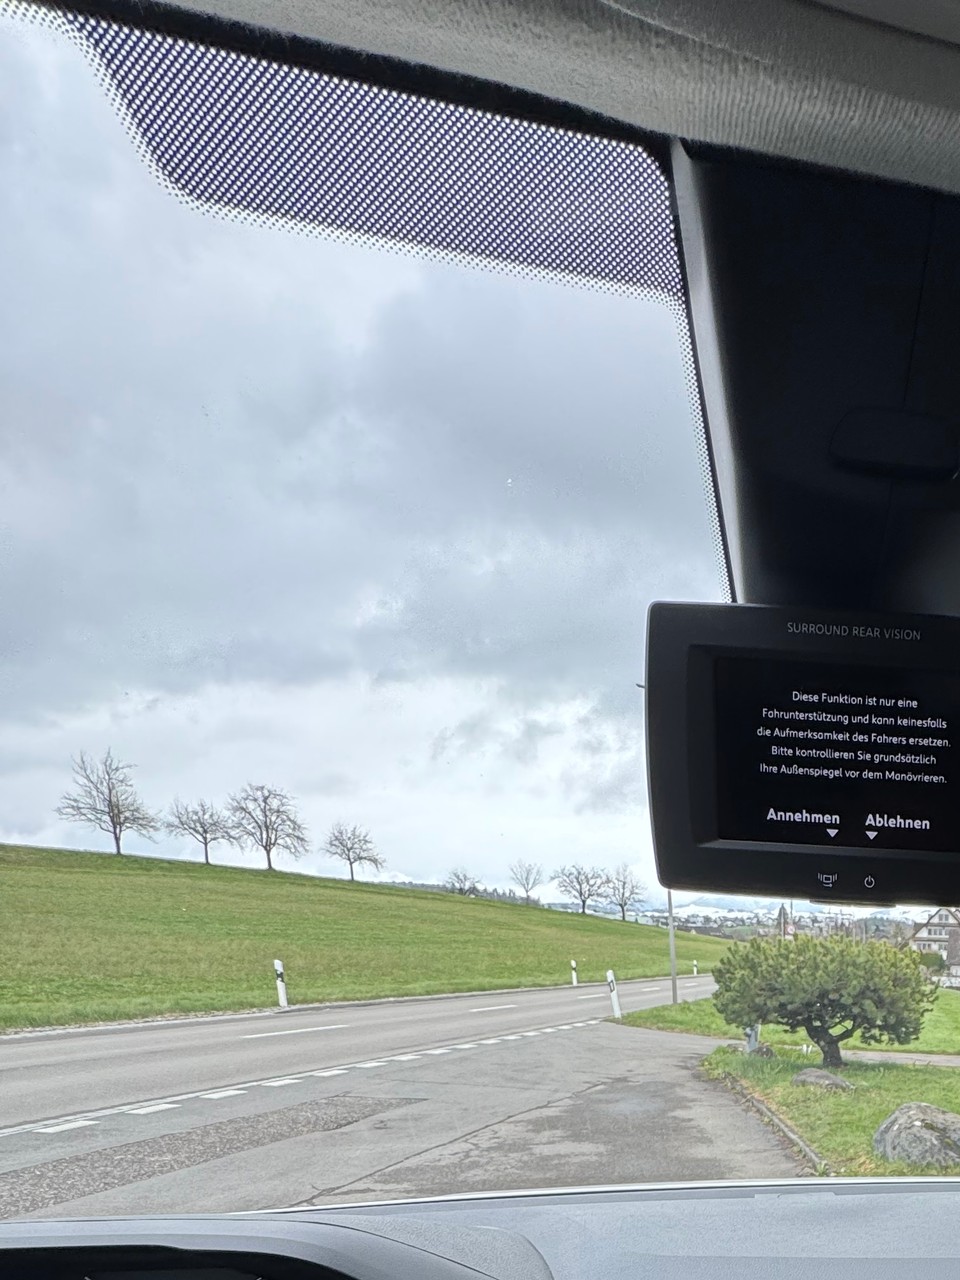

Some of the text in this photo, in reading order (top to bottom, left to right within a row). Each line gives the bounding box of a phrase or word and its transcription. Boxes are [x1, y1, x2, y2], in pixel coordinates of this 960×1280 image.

[787, 622, 921, 640] SURROUND REAR VISION
[792, 690, 918, 709] Diese Funktion ist nur eine
[762, 707, 948, 729] Fahrunterstützung und kann keinesfalls
[756, 726, 952, 748] die Aufmerksamkeit des Fahrers ersetzen.
[771, 745, 937, 765] Bitte kontrollieren Sie grundsätzlich
[759, 762, 948, 784] Ihre Außenspiegel vor dem Manövrieren.
[766, 808, 840, 824] Annehmen
[865, 813, 931, 830] Ablehnen
